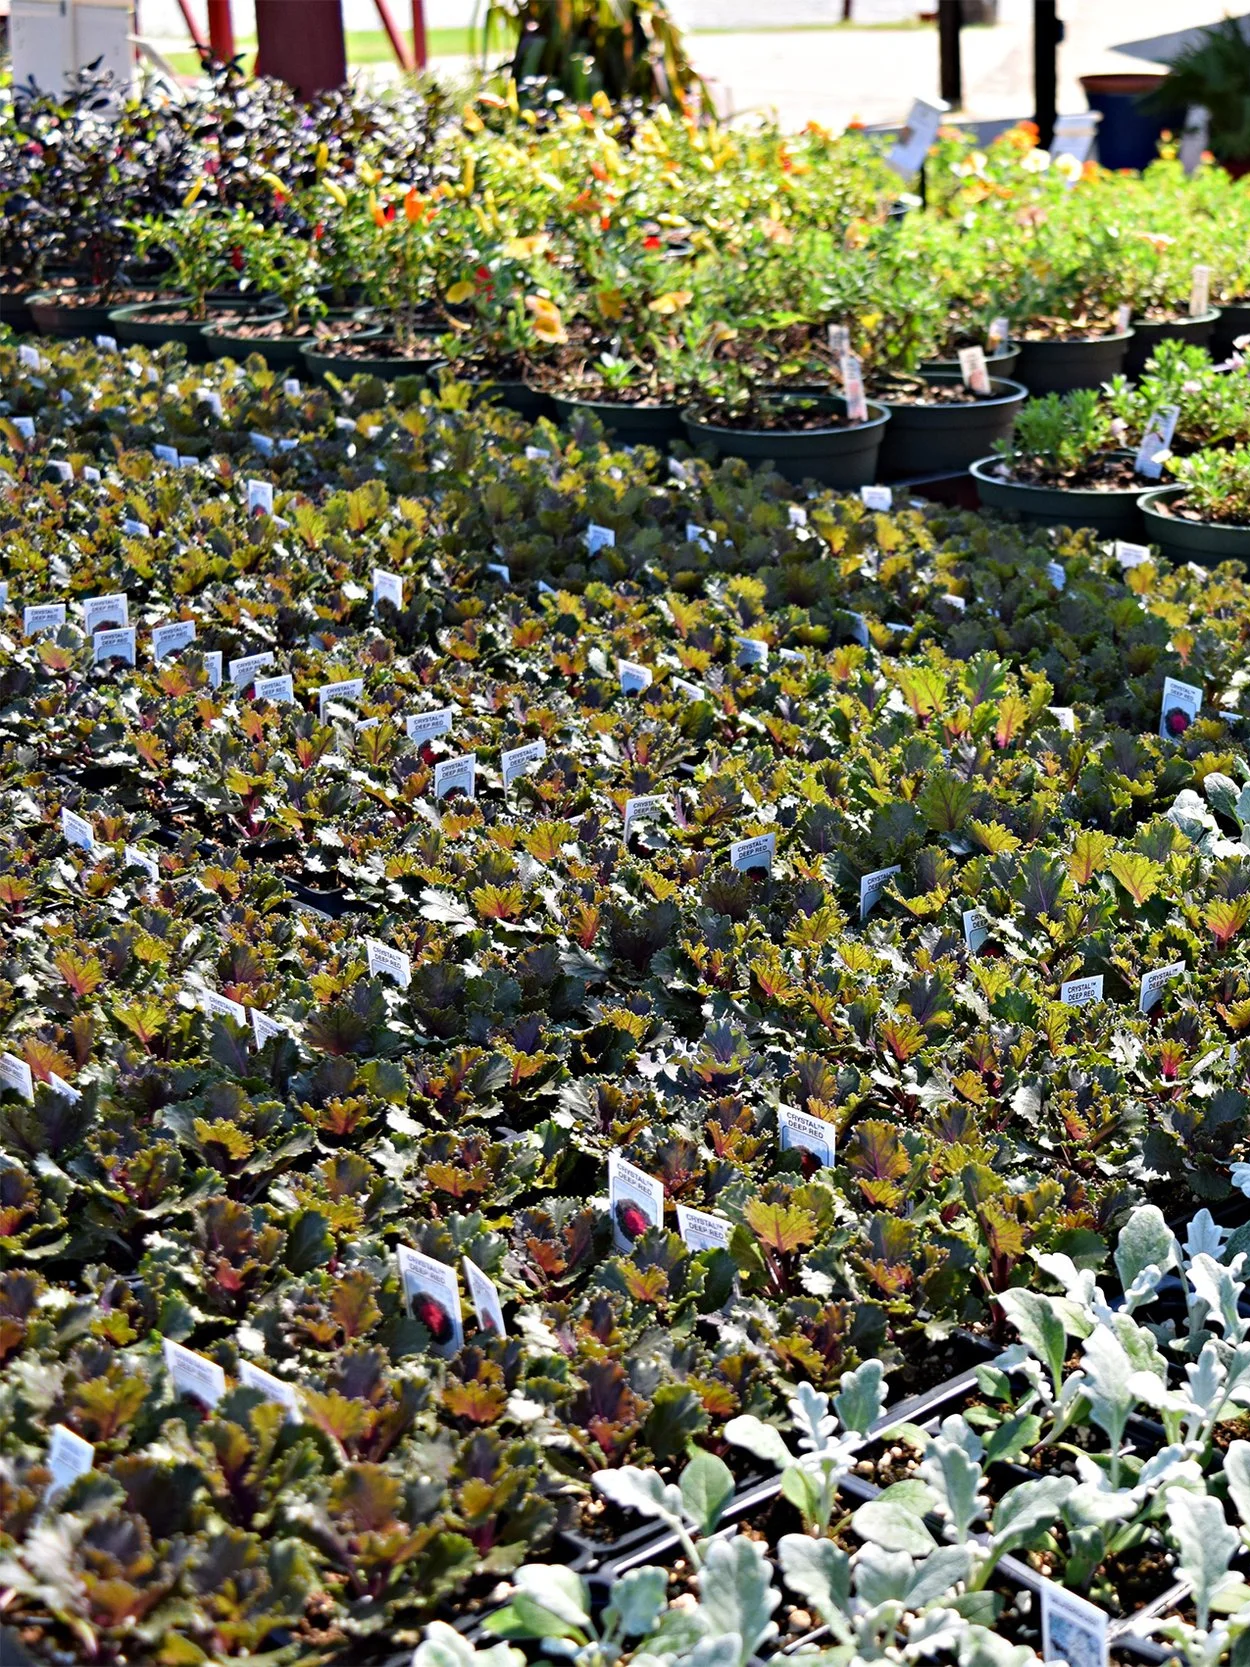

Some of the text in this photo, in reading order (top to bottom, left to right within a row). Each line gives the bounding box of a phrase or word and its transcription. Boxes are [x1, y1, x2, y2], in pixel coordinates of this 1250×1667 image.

[1067, 982, 1097, 993] CRYSTAL™
[1068, 989, 1095, 1001] DEEP RED
[786, 1112, 825, 1130] CRYSTAL™
[788, 1120, 824, 1139] DEEP RED
